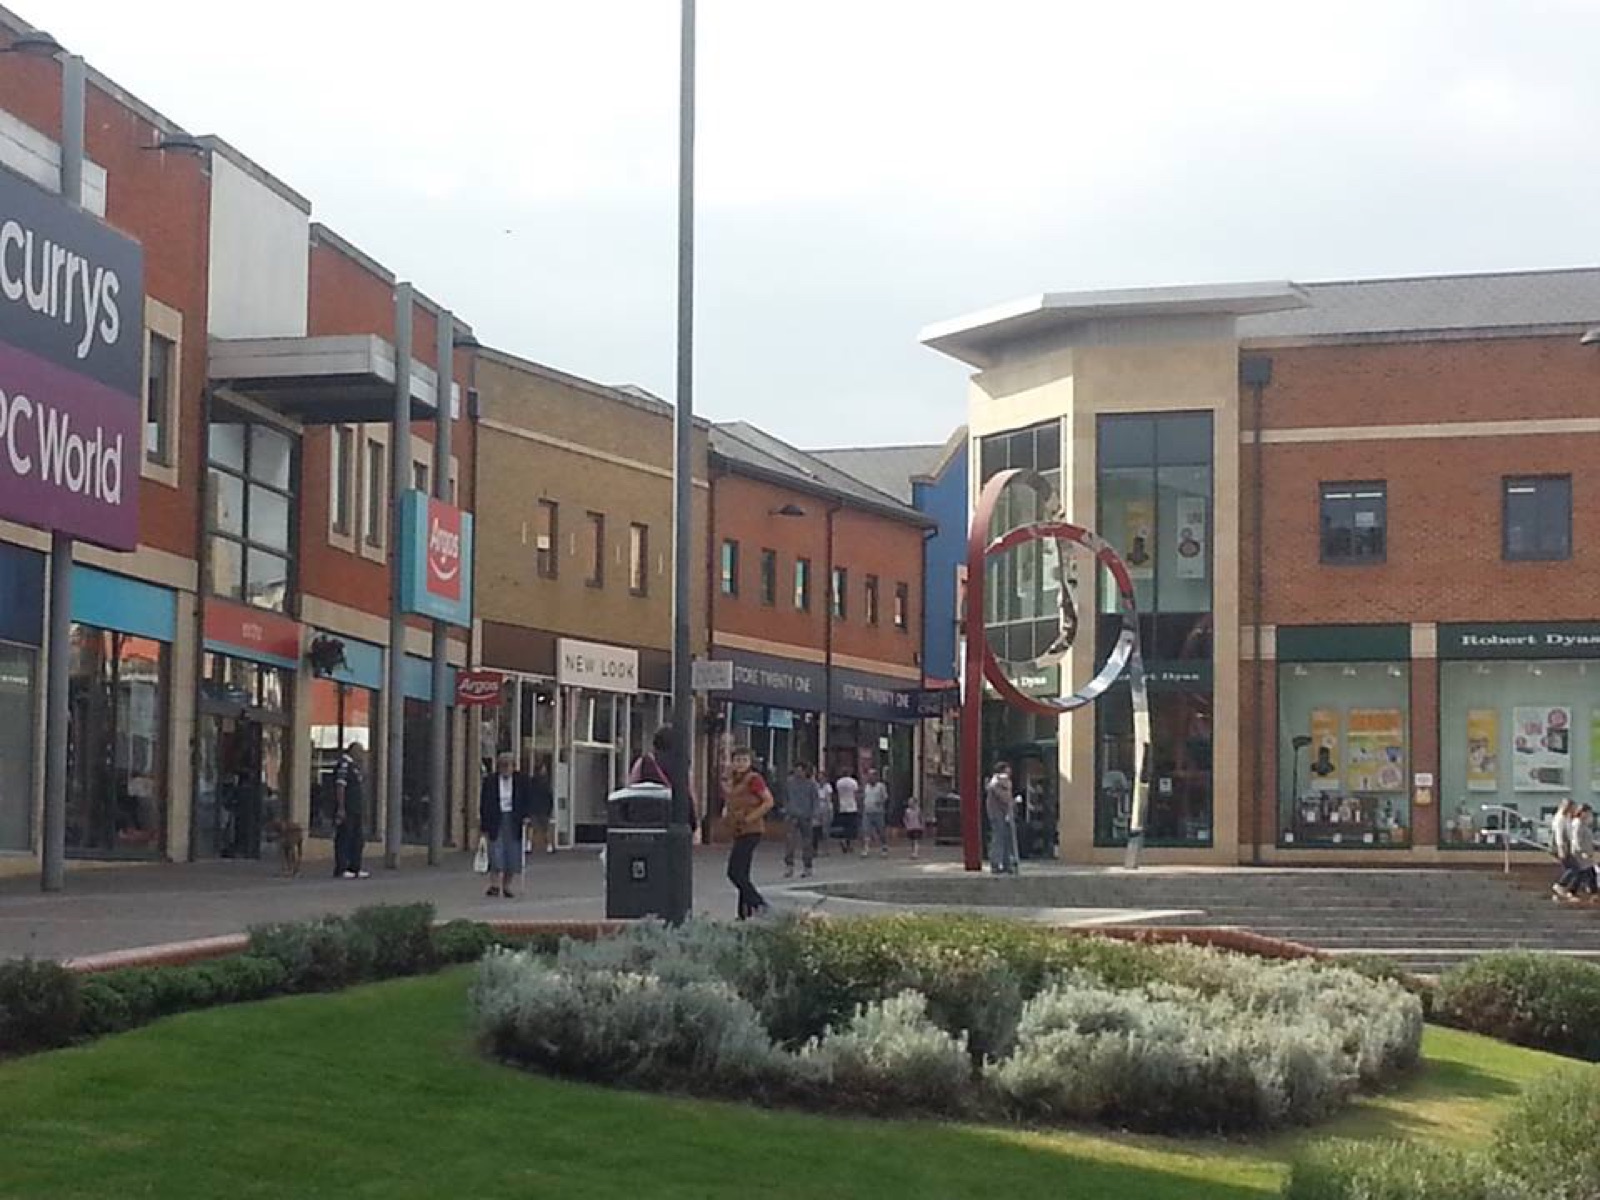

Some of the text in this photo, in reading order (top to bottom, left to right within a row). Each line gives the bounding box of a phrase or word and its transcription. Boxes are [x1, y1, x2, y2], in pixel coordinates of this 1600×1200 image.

[38, 402, 122, 505] World
[1462, 633, 1537, 645] Robert
[565, 654, 634, 679] NEW LOOK
[457, 676, 499, 694] Argos
